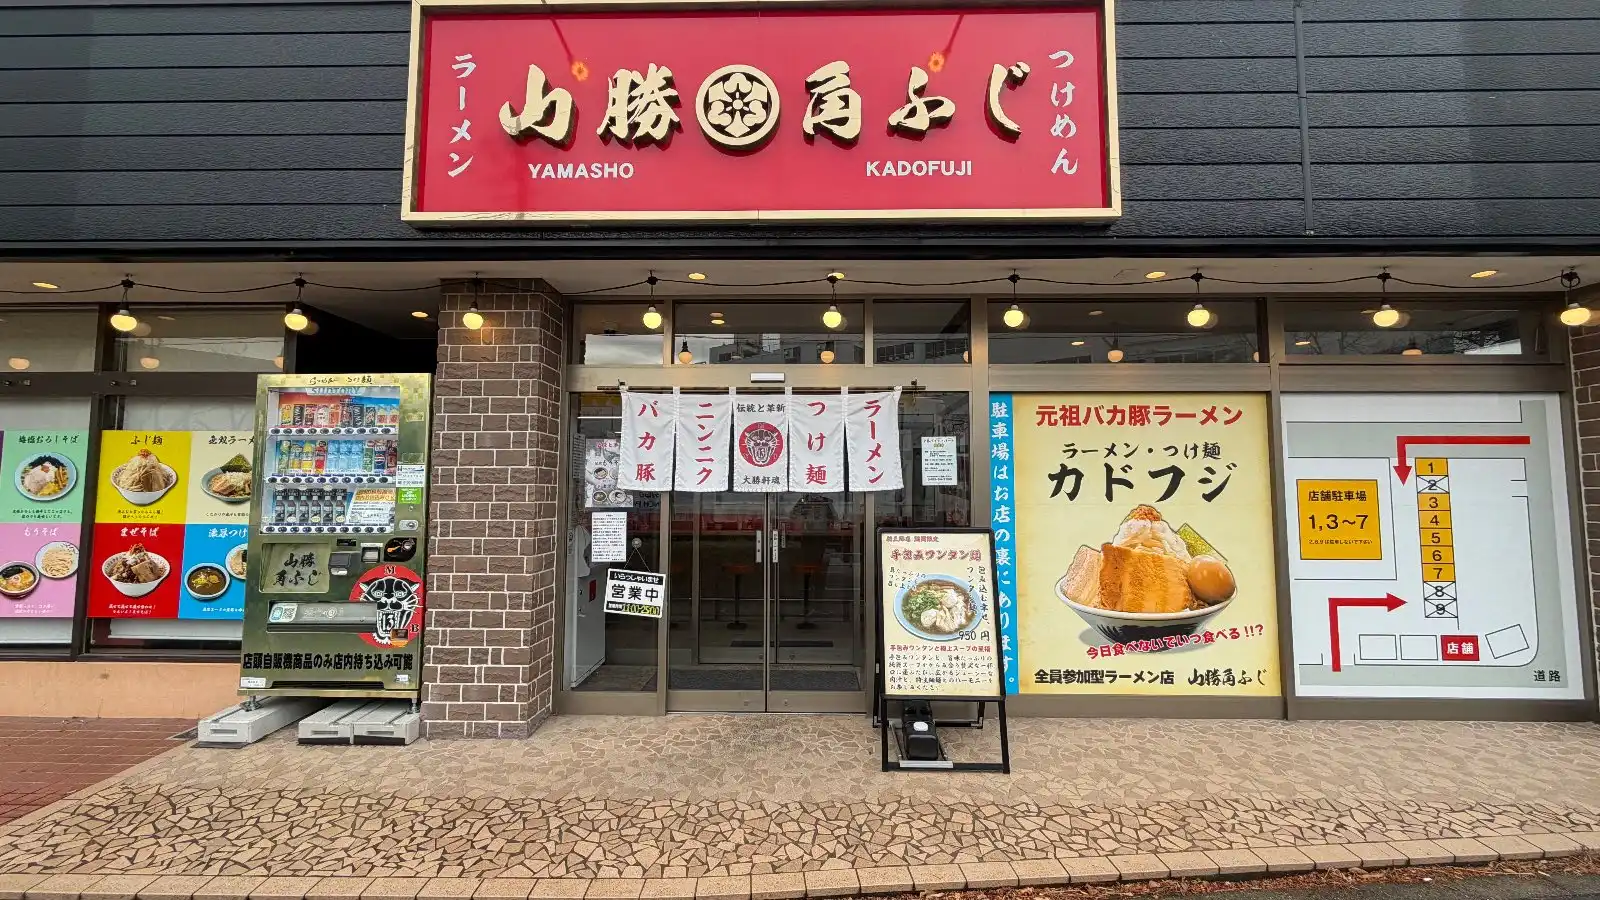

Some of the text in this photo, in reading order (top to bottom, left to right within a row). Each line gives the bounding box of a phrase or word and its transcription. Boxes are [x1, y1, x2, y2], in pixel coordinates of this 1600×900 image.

[499, 60, 1030, 145] 山勝 角ふじ
[448, 53, 477, 178] ラーメン
[1048, 50, 1079, 175] つけめん
[528, 162, 635, 179] YAMASHO
[866, 160, 973, 177] KADOFUJI
[737, 403, 786, 413] 伝統と革新
[1035, 404, 1243, 427] 元祖バカ豚ラーメン
[130, 434, 163, 446] ふじ麺
[634, 400, 660, 482] バカ豚
[695, 402, 716, 485] ニンニク
[805, 401, 828, 485] つけ麺
[864, 399, 885, 484] ラーメン
[1062, 441, 1221, 460] ラーメン・つけ麺
[1427, 462, 1434, 474] 1
[742, 475, 781, 485] 大勝軒魂
[1047, 462, 1238, 503] カドフジ
[1428, 479, 1437, 491] 2
[1308, 490, 1367, 502] 店舗駐車場
[1428, 497, 1438, 509] 3
[1430, 515, 1440, 527] 4
[120, 526, 159, 538] まぜそば
[1431, 532, 1441, 544] 5
[991, 402, 1016, 684] 駐車場はお店の裏にあります。
[284, 553, 316, 568] 山勝
[1432, 550, 1442, 561] 6
[273, 569, 322, 586] 角ふじ
[613, 572, 660, 584] いらっしゃいませ
[1432, 567, 1443, 579] 7
[611, 583, 659, 603] 営業中
[1435, 585, 1444, 597] 8
[1436, 603, 1446, 615] 9
[1446, 641, 1474, 655] 店舗
[243, 653, 413, 671] 店頭自販機商品のみ店内持ち込み可能
[1034, 667, 1268, 688] 全員参加型ラーメン店 山勝角ふじ
[1533, 670, 1561, 682] 道路
